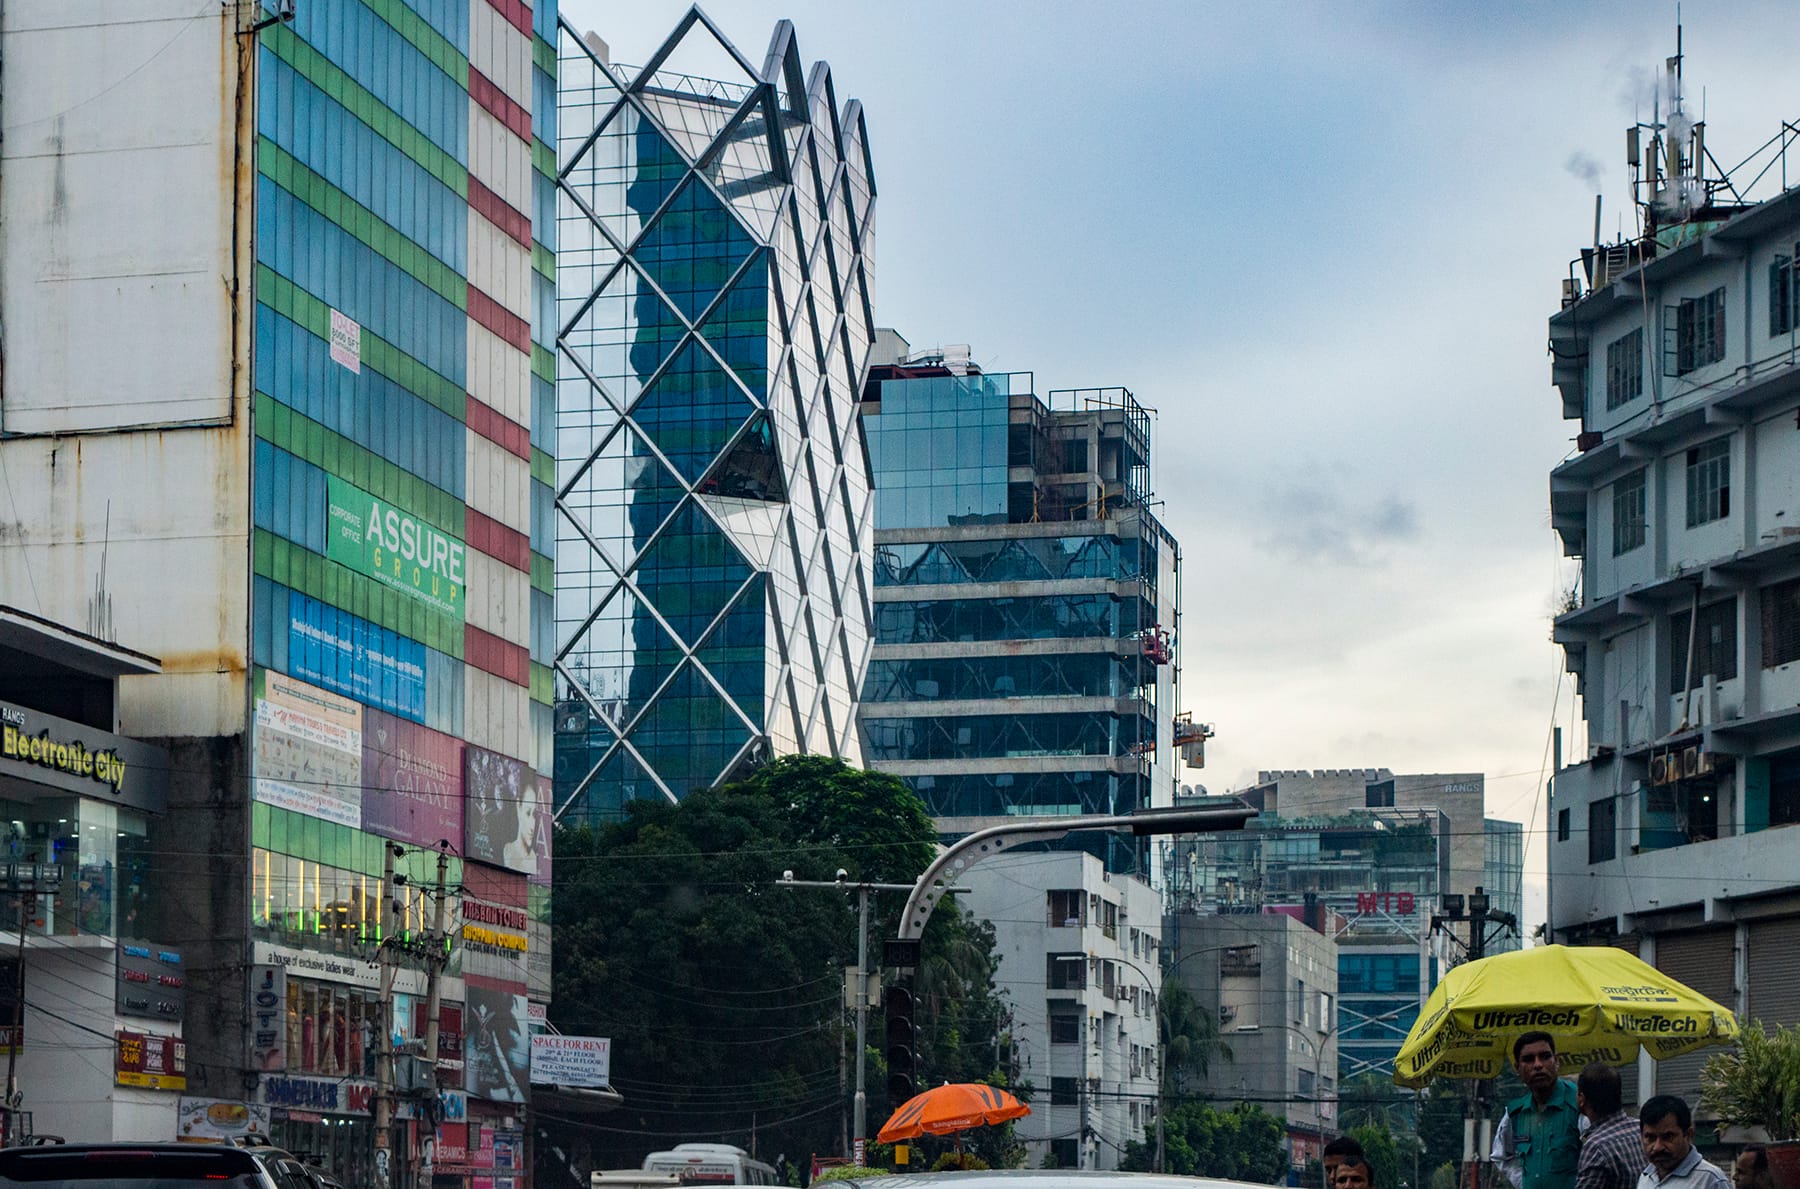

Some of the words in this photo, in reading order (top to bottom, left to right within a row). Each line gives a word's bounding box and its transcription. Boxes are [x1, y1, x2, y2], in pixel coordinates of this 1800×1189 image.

[329, 504, 361, 528] CORPORATE
[341, 526, 361, 544] OFFICE
[366, 502, 463, 585] ASSURE
[2, 708, 25, 725] RANGS
[3, 725, 93, 776] Electronic
[95, 748, 126, 791] City
[400, 749, 447, 781] DIAMOND
[394, 770, 451, 810] GALAXY
[1444, 783, 1480, 793] RANGS
[1357, 892, 1415, 914] MTB
[498, 908, 527, 930] TOWER
[268, 953, 273, 962] a
[273, 952, 291, 967] house
[299, 958, 325, 972] exclusive
[325, 960, 342, 975] ladies
[1474, 1008, 1580, 1030] UltraTech
[1615, 1013, 1698, 1033] UltraTech
[533, 1037, 560, 1048] SPACE
[563, 1040, 583, 1050] FOR
[583, 1042, 607, 1053] RENT
[268, 1077, 339, 1110] SHINEPUKUR
